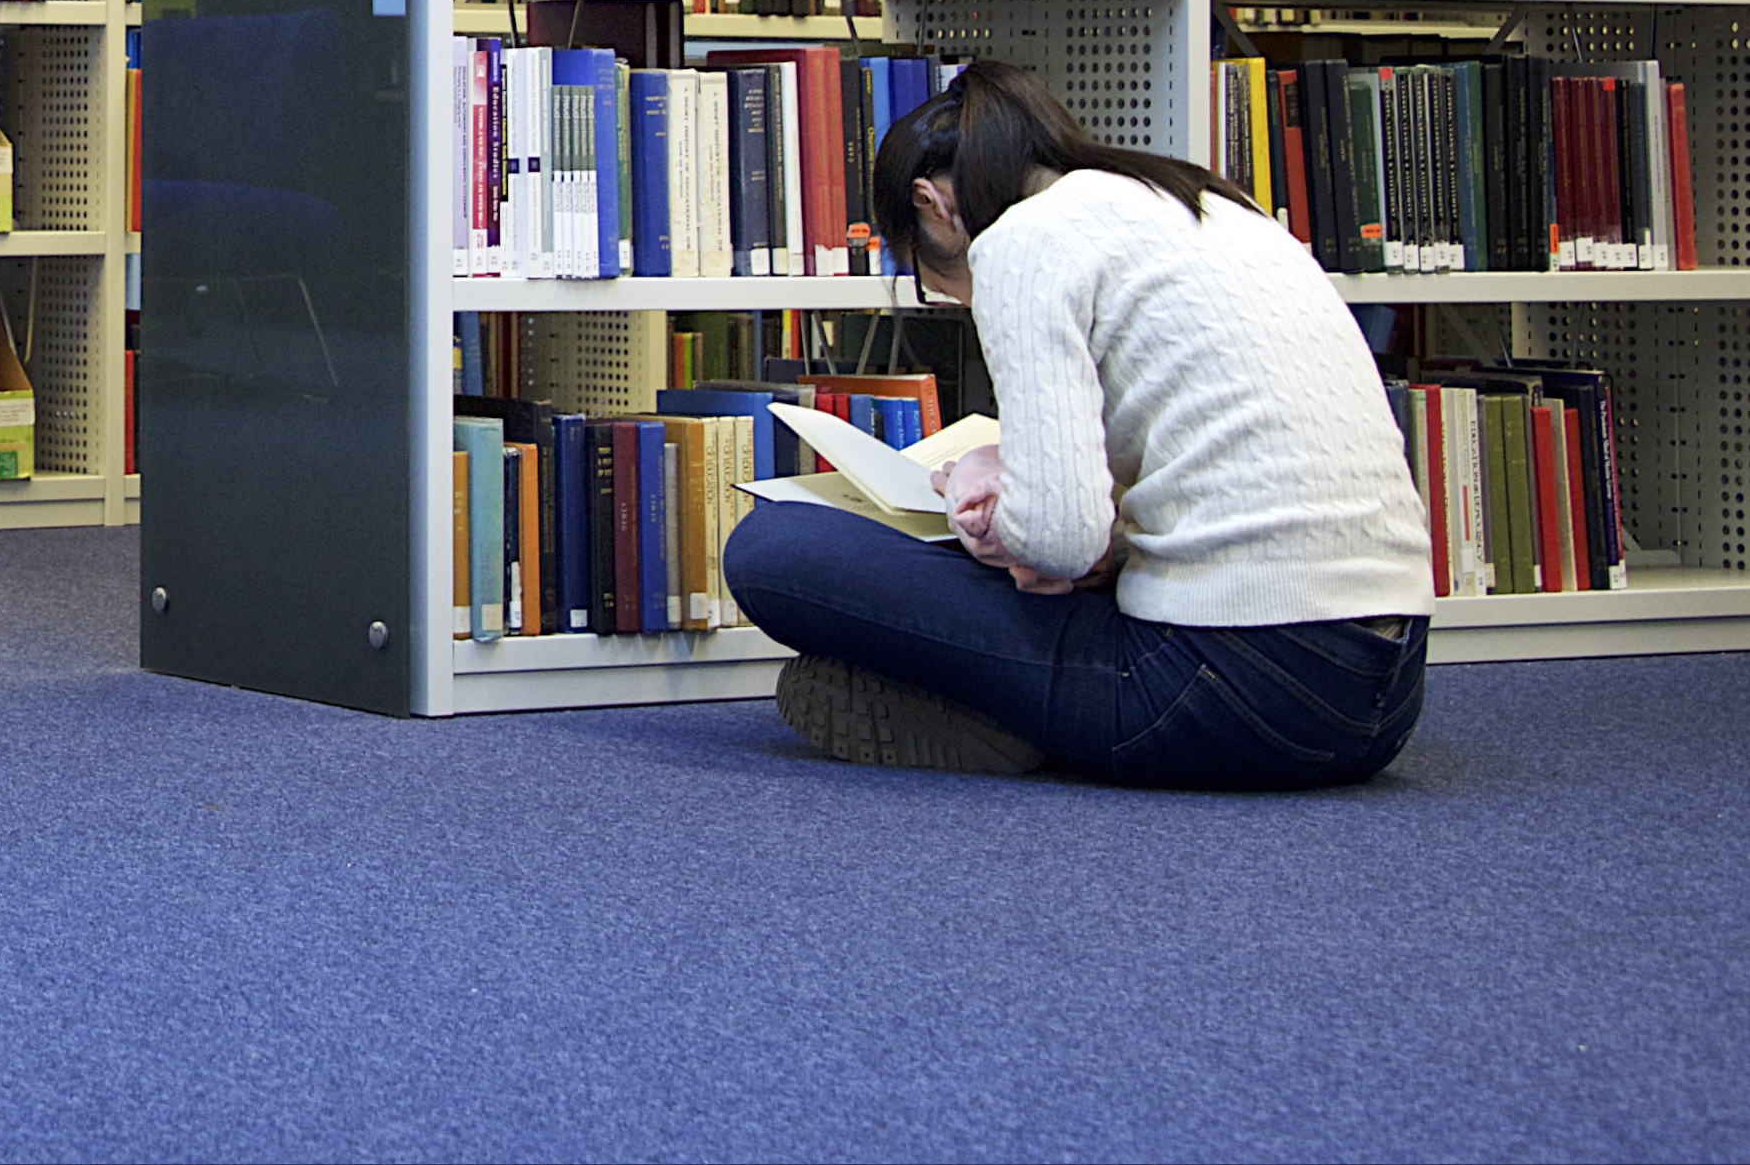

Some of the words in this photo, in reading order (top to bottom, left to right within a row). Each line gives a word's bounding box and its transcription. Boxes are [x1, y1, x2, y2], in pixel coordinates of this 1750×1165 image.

[685, 162, 689, 173] OF
[1600, 411, 1608, 439] Passionate
[707, 446, 713, 458] OF
[1470, 420, 1479, 482] EDUCATION
